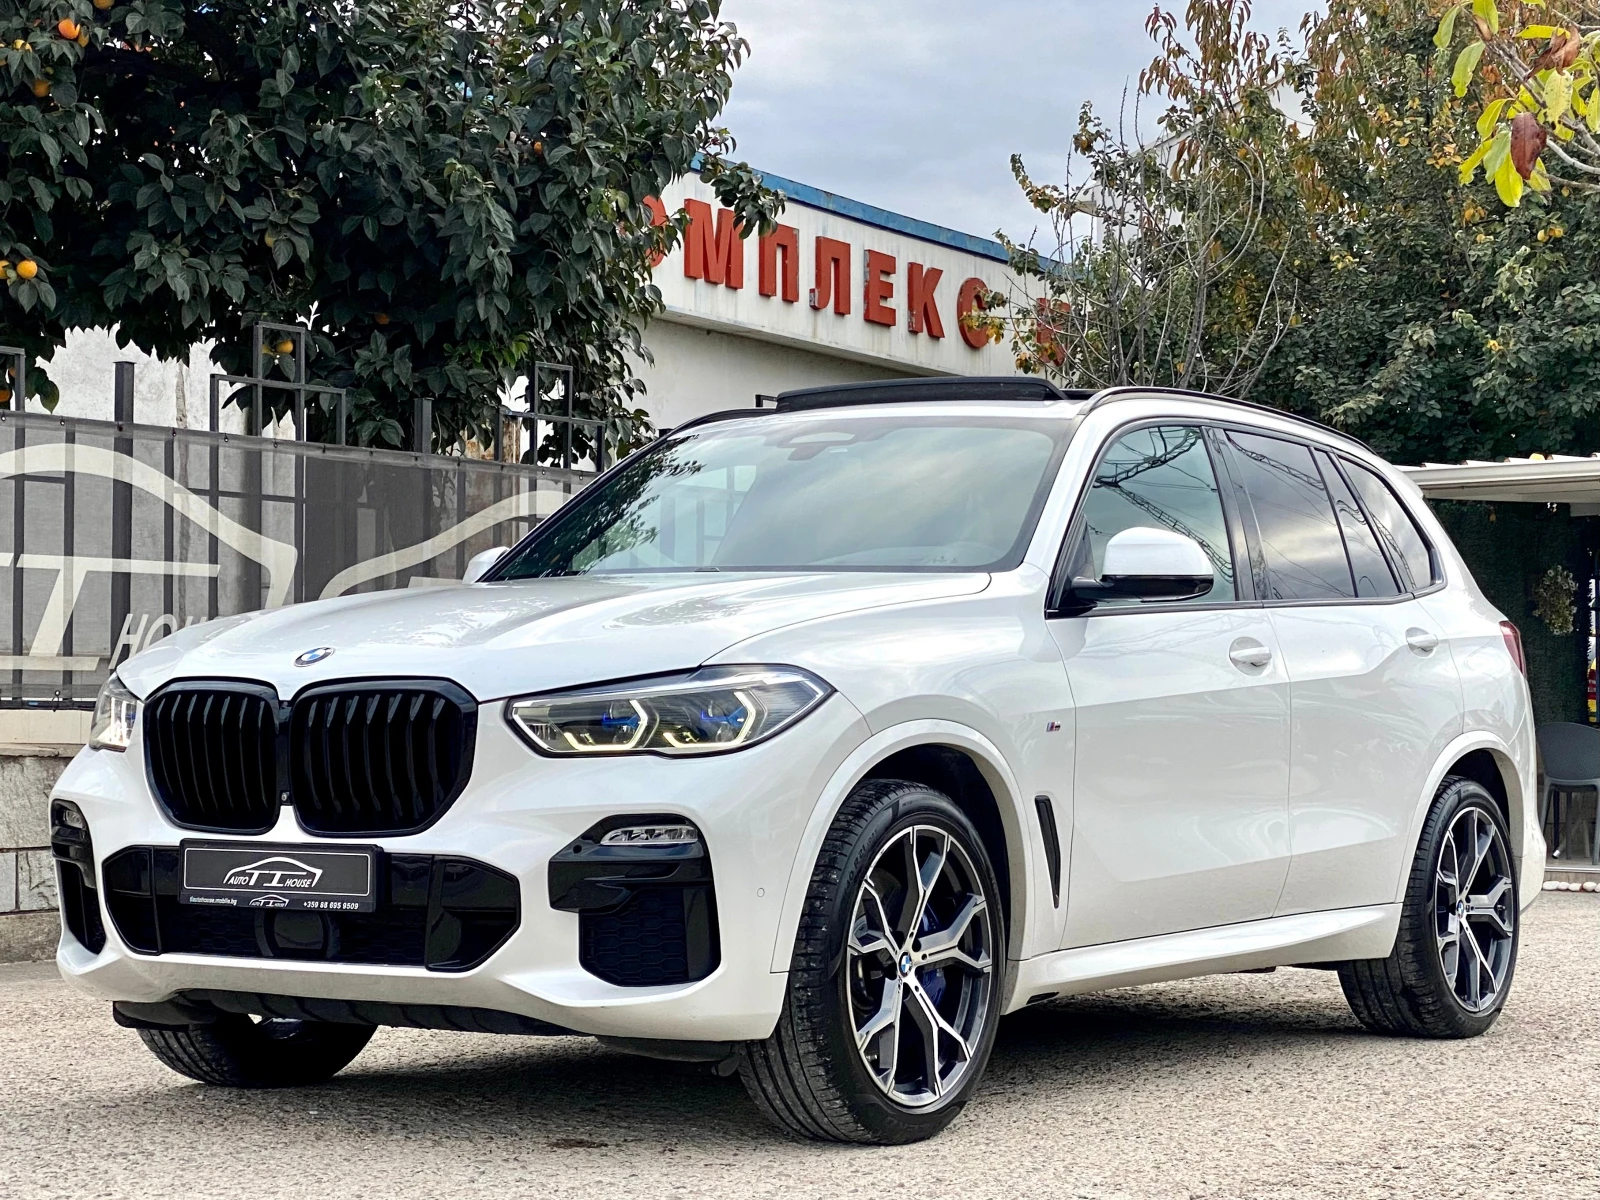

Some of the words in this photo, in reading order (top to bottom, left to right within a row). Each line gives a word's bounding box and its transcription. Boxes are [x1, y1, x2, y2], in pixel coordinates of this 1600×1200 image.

[228, 876, 249, 885] AUTO
[284, 878, 312, 888] HOUSE
[303, 901, 319, 909] +359
[320, 901, 329, 909] 88
